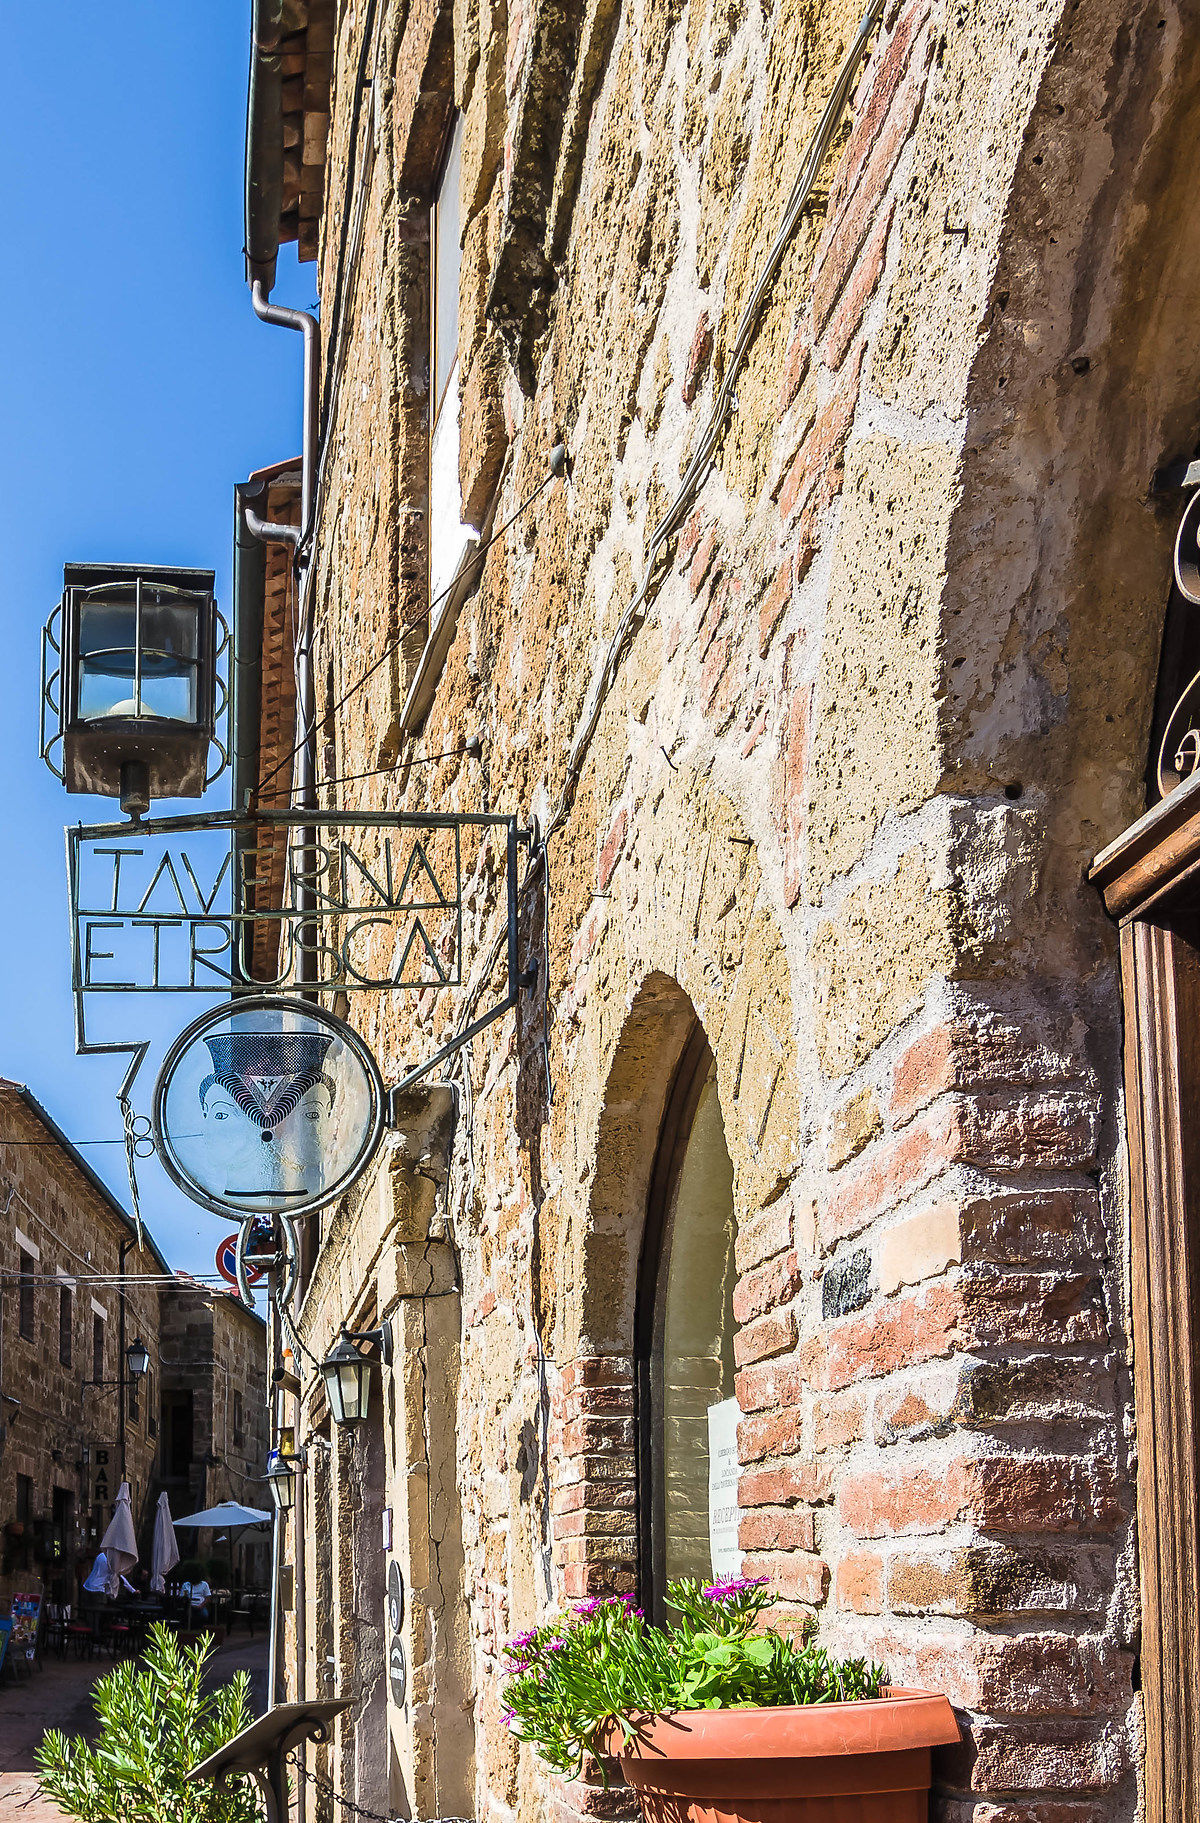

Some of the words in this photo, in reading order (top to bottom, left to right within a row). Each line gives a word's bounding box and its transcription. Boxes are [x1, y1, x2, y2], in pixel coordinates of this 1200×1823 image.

[93, 839, 447, 914] TAVERNA
[84, 916, 448, 987] ETRUSCA
[95, 1450, 109, 1500] BAR
